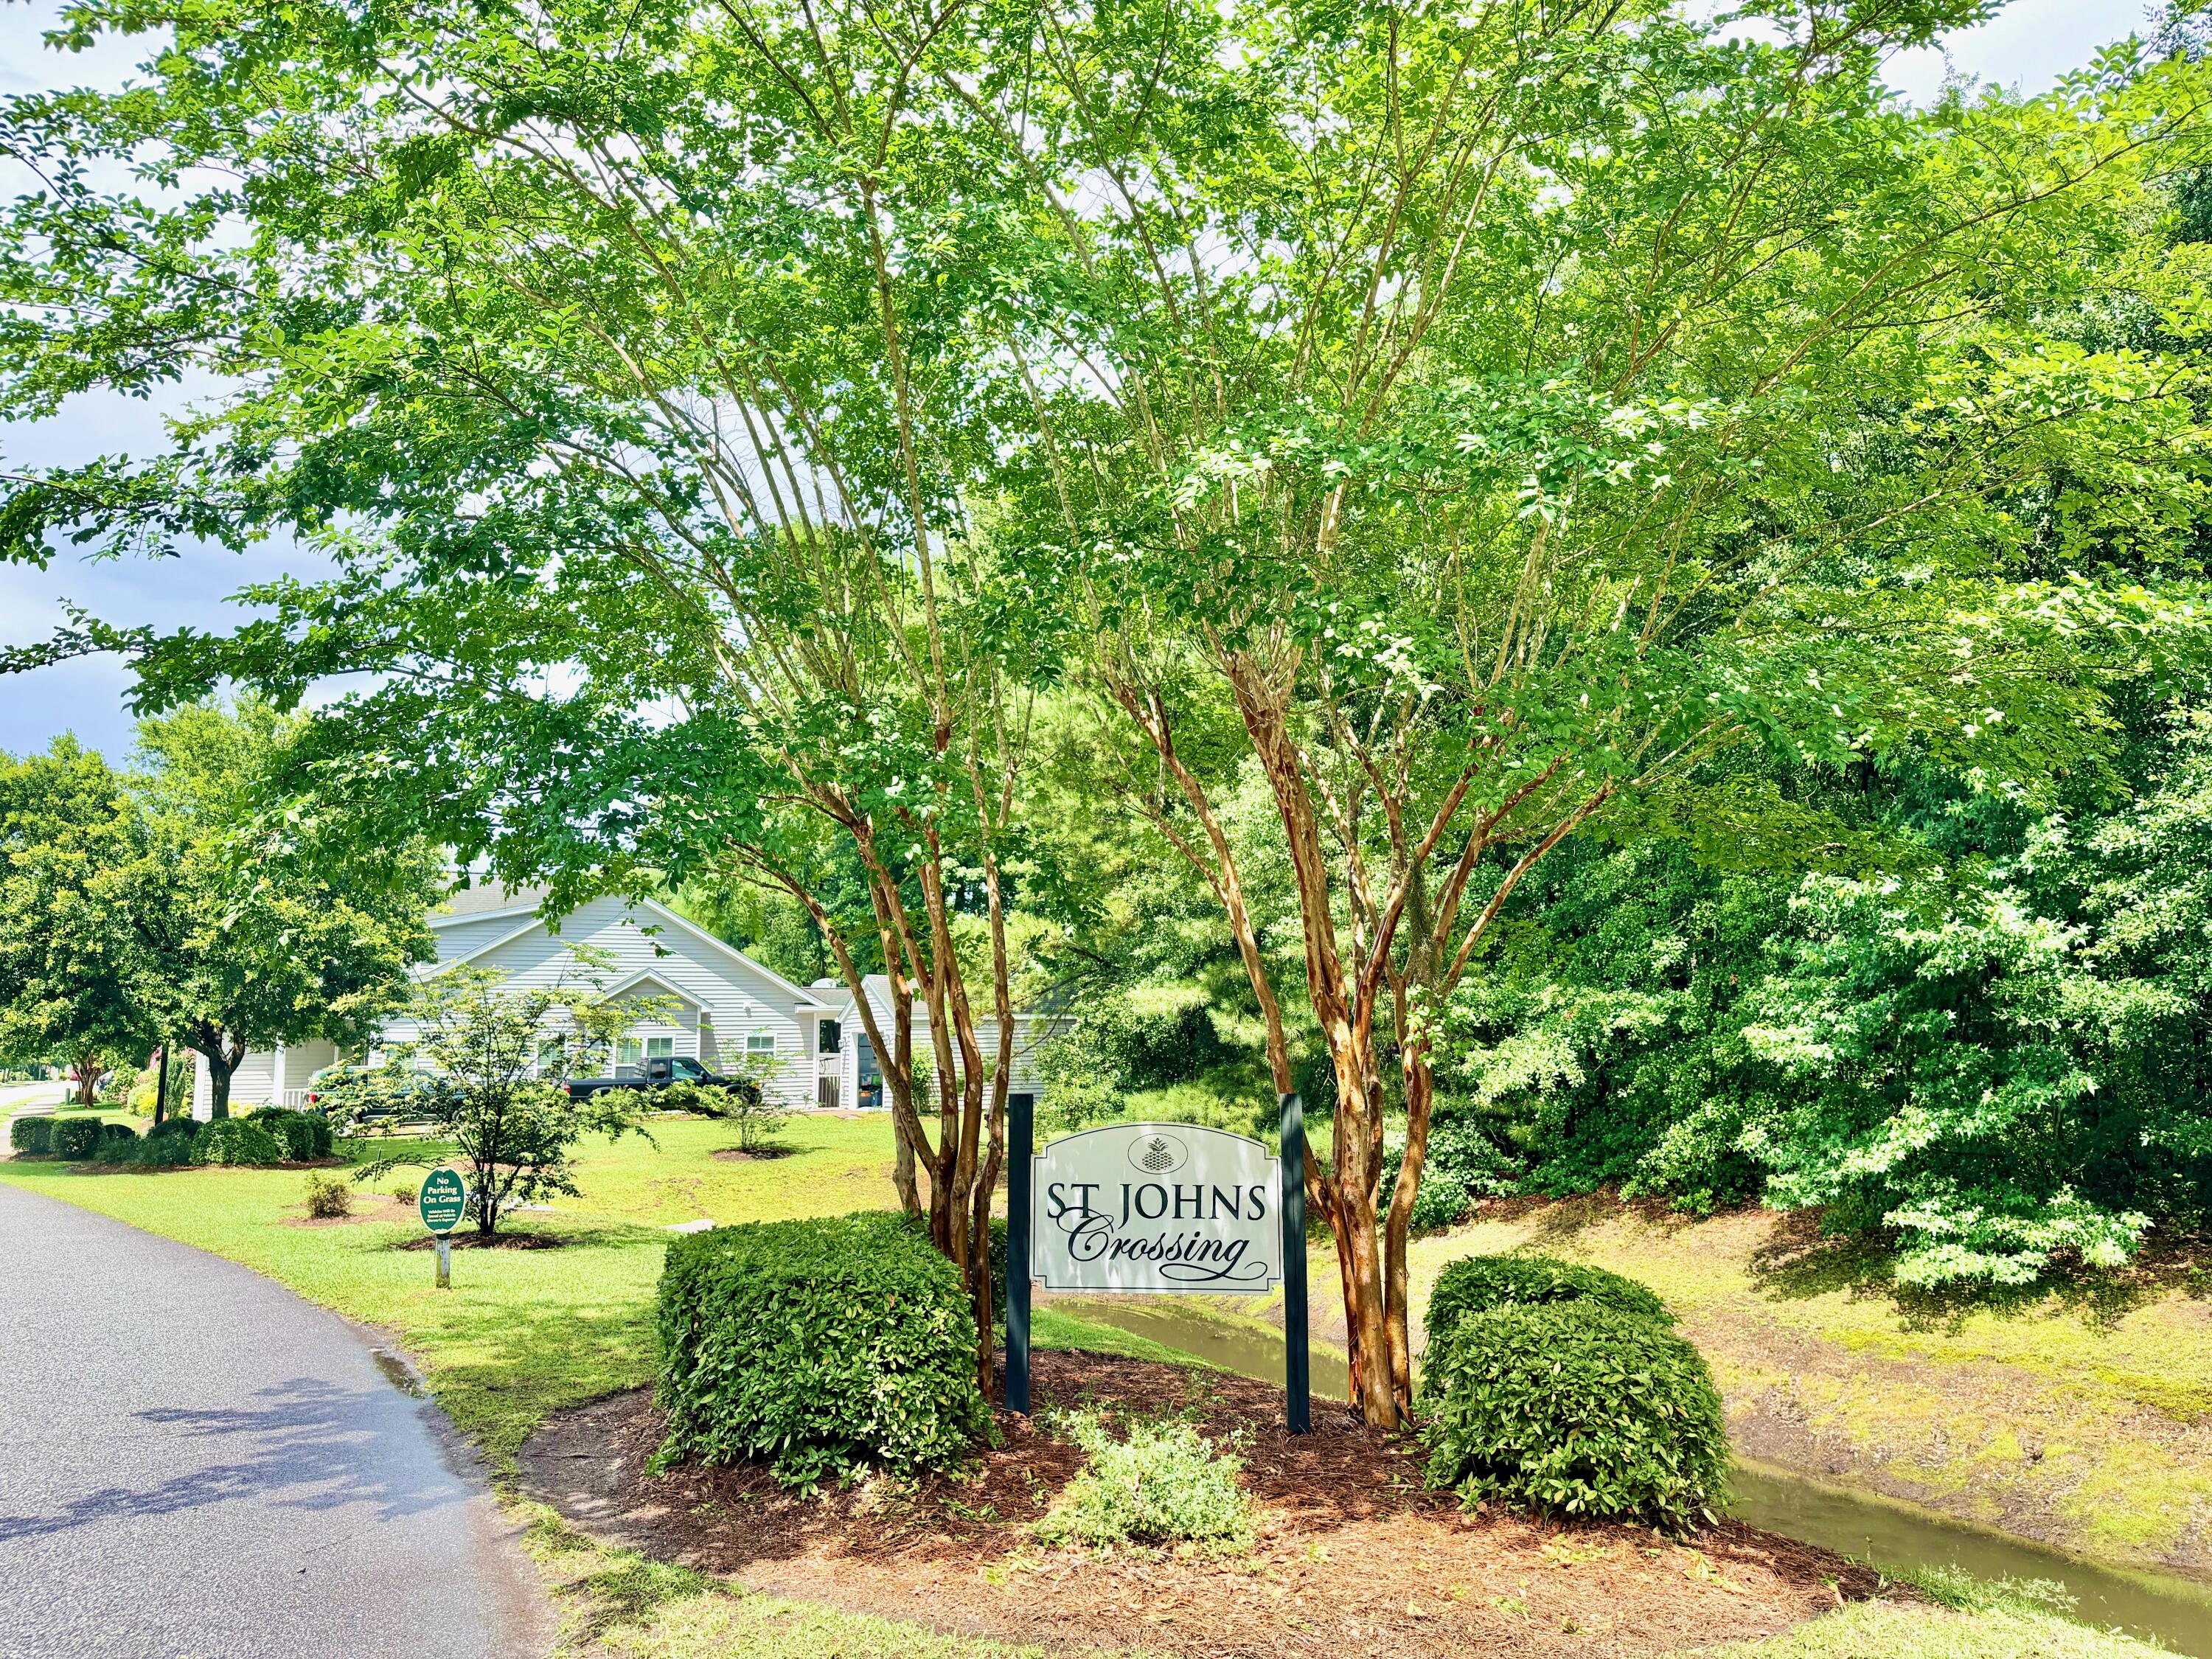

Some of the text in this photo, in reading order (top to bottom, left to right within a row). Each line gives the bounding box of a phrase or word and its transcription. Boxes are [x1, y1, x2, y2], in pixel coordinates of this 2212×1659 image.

[428, 1186, 457, 1195] Parking
[1047, 1183, 1266, 1230] ST JOHNS
[1057, 1206, 1268, 1281] Crossing
